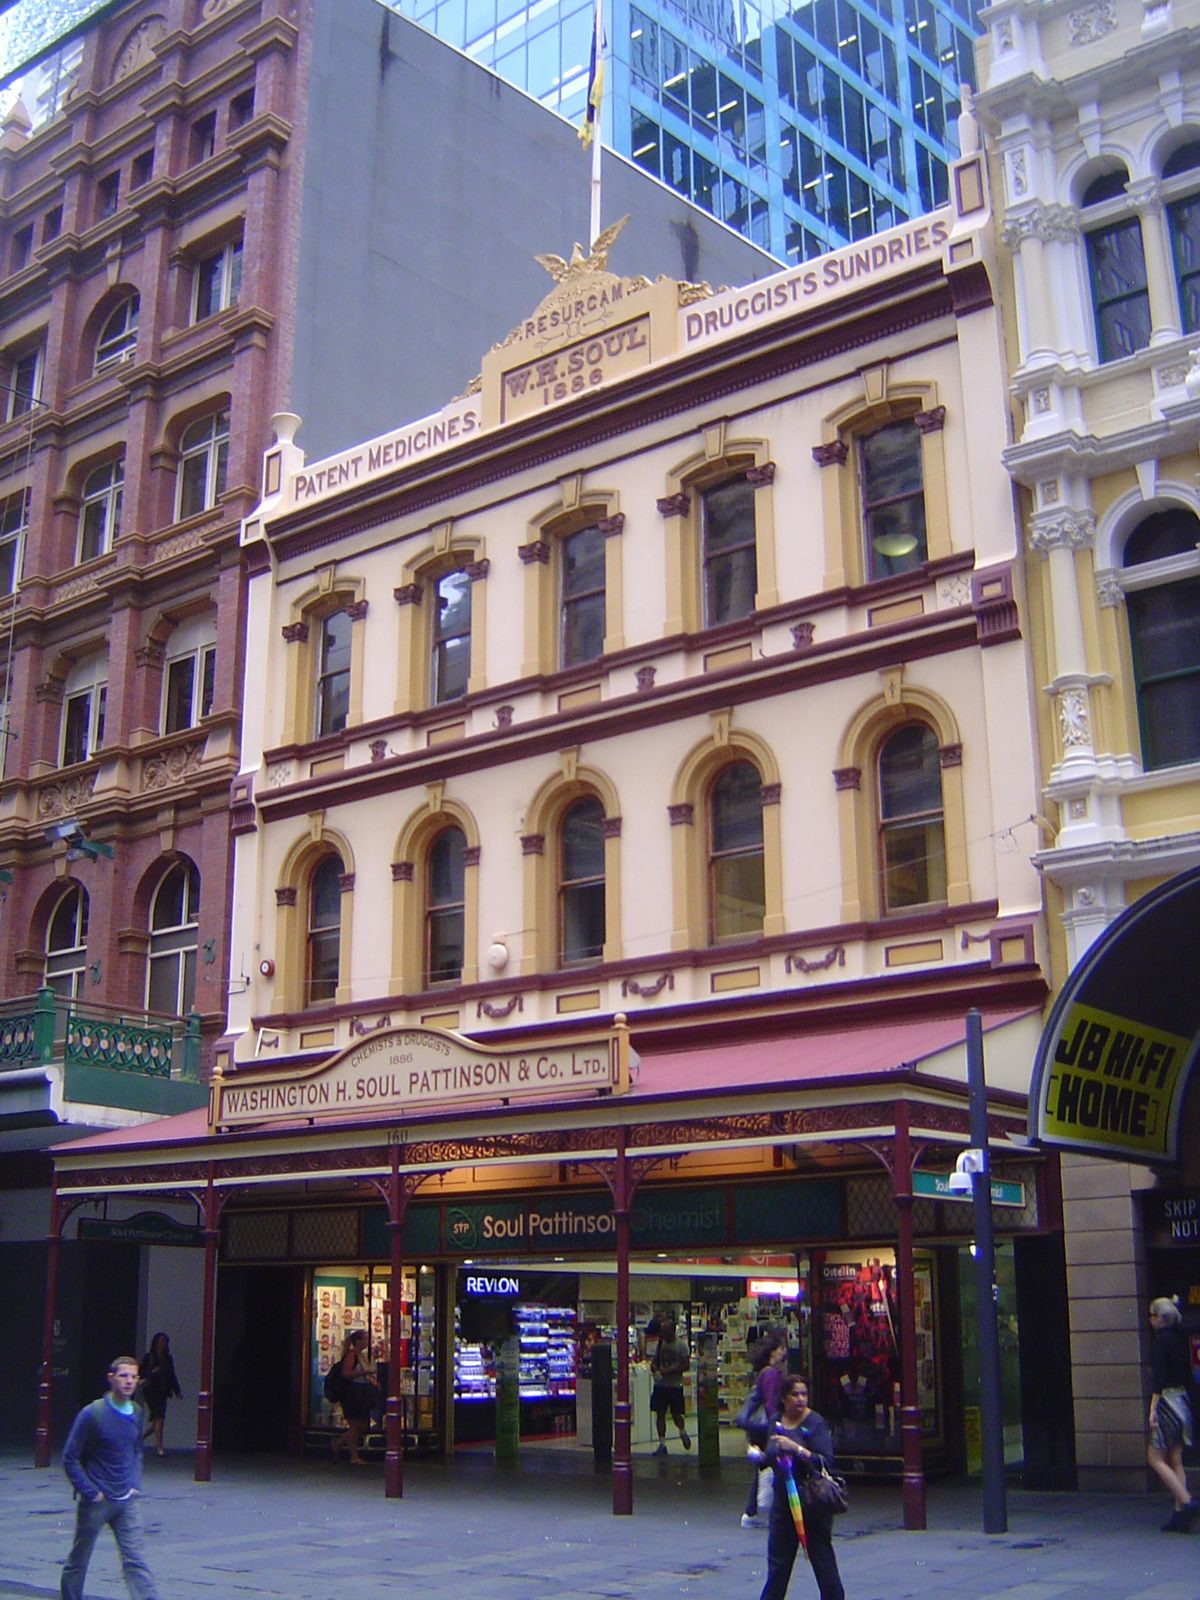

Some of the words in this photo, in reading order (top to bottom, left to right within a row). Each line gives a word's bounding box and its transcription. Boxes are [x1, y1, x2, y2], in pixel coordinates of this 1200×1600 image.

[686, 272, 818, 342] DRUGGISTS
[822, 220, 949, 287] SUNDRIES
[543, 368, 603, 405] 1886
[295, 455, 362, 500] PATENT
[351, 1038, 394, 1068] CHEMISTS
[396, 1035, 402, 1046] &
[404, 1034, 452, 1057] DRUGGISTS
[389, 1052, 413, 1065] 1886
[1055, 1019, 1110, 1072] JB
[1103, 1030, 1176, 1089] HI-FI
[227, 1082, 329, 1112] WASHINGTON
[336, 1080, 352, 1101] H.
[356, 1074, 400, 1099] SOUL
[409, 1060, 510, 1093] PATTINSON
[518, 1059, 530, 1081] &
[1056, 1072, 1150, 1137] HOME
[1164, 1199, 1196, 1217] SKIP
[483, 1213, 523, 1239] Soul
[466, 1276, 519, 1294] REVLON
[823, 1265, 856, 1278] Ostelin
